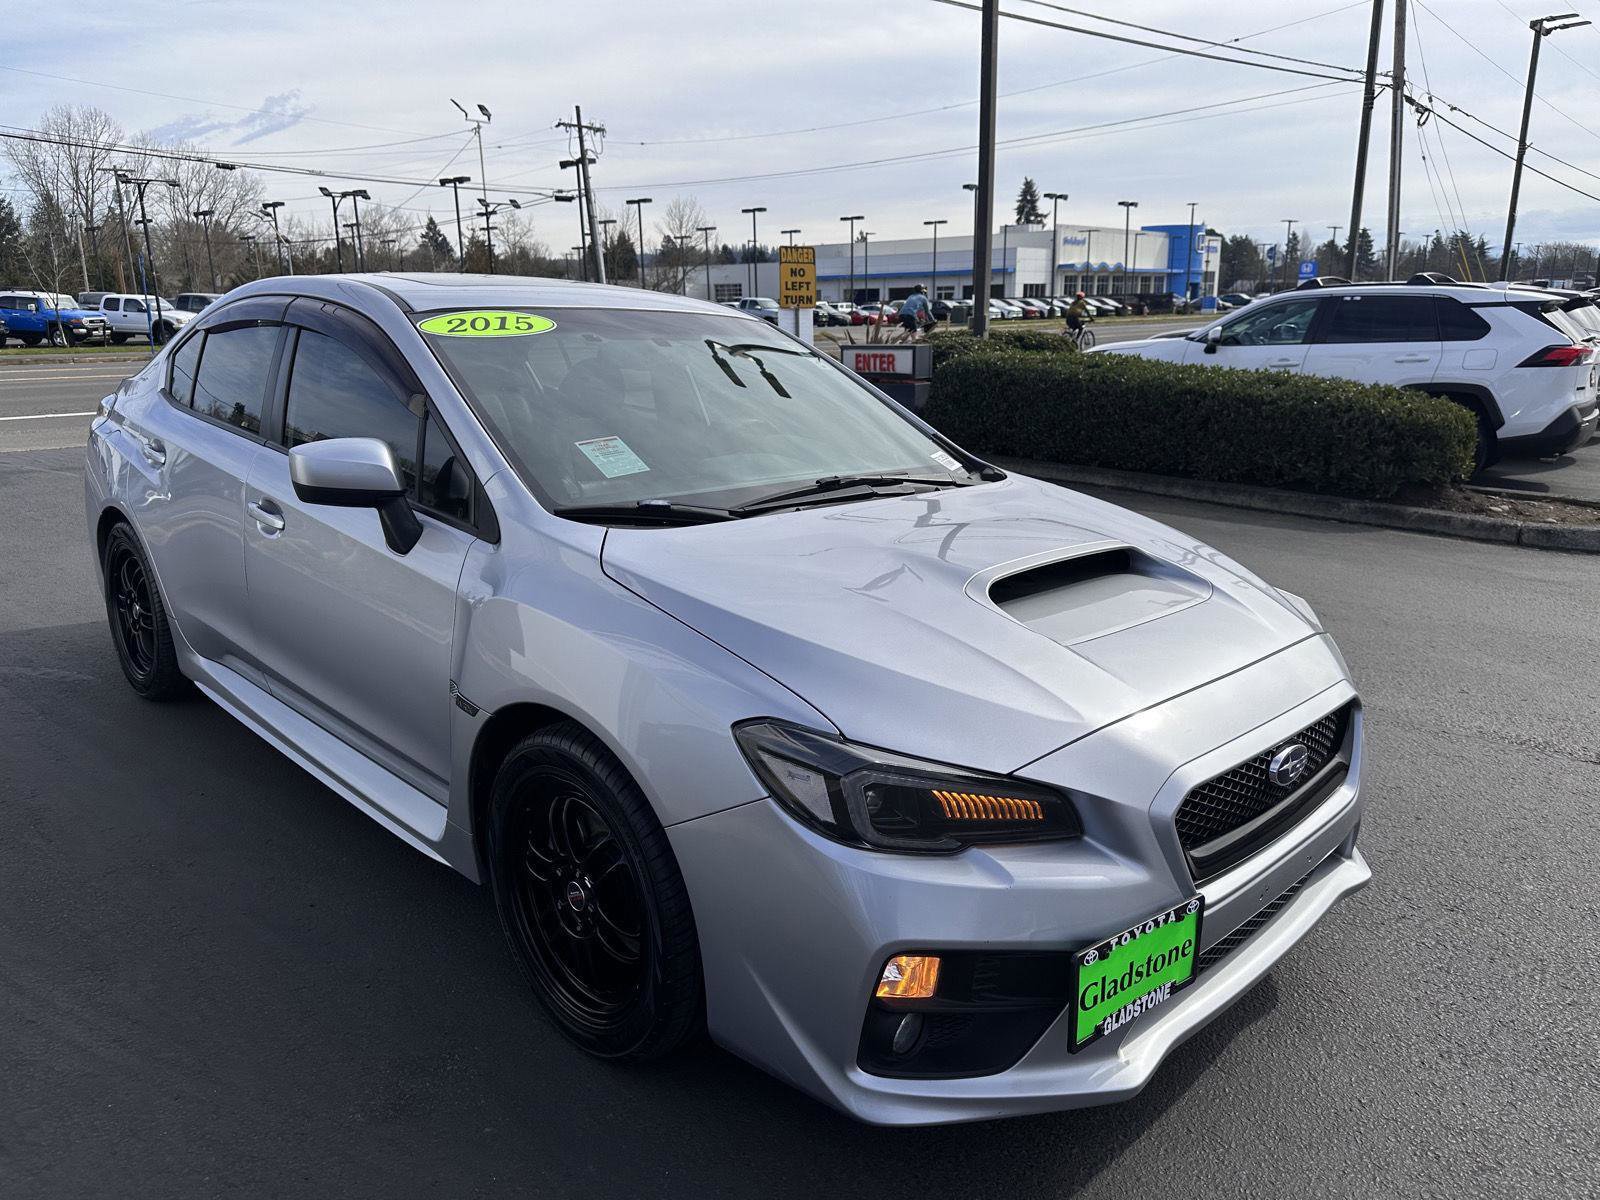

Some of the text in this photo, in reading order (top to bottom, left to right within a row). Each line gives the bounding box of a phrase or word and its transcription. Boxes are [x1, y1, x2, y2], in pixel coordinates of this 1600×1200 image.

[780, 247, 814, 262] DANGER
[790, 267, 806, 278] NO
[785, 281, 812, 291] LEFT
[783, 295, 813, 305] TURN
[446, 316, 534, 333] 2015
[855, 352, 896, 372] ENTER
[1110, 911, 1176, 951] TOYOTA
[1080, 938, 1193, 1012] Gladstone
[1104, 982, 1172, 1036] GLADSTONE
